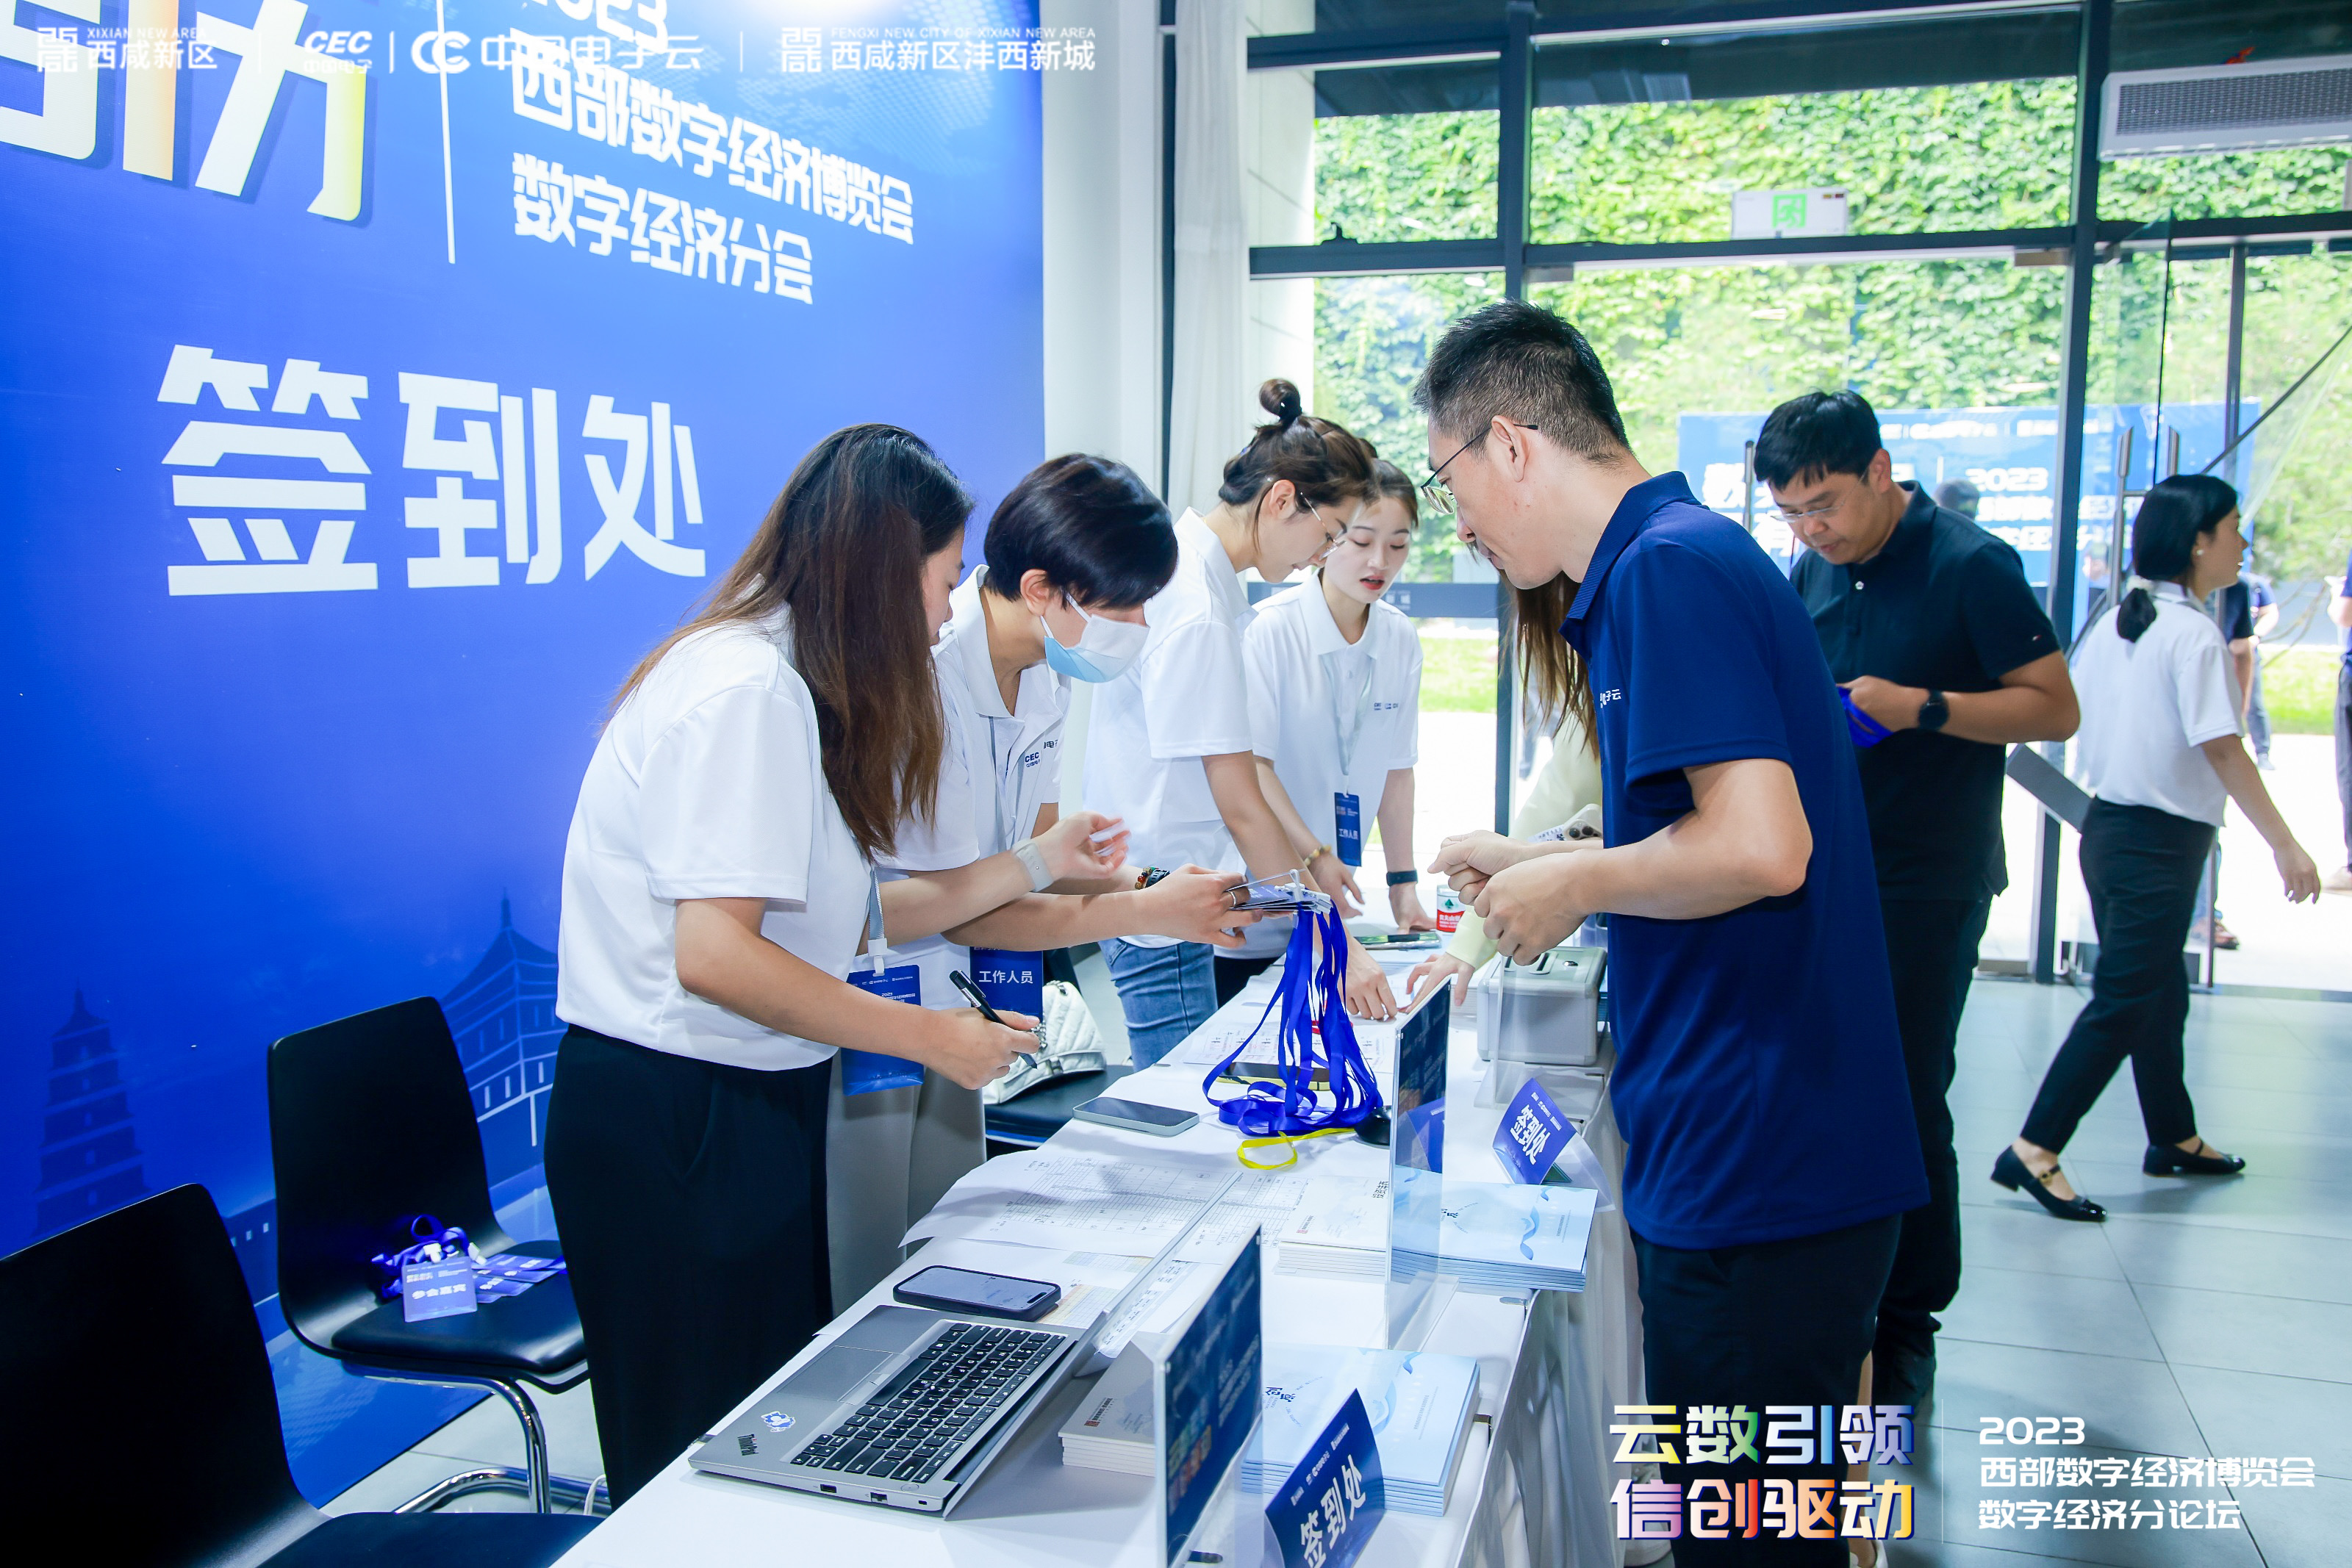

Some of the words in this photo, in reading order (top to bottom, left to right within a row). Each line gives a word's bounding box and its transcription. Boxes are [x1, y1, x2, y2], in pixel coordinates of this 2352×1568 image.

[510, 28, 914, 245] 西部数字经济博览会
[512, 152, 814, 304] 数字经济分会
[157, 345, 706, 597] 签到处
[1025, 752, 1039, 763] CEC
[978, 970, 1033, 984] 工作人员
[1510, 1104, 1551, 1165] 签到处
[737, 1434, 759, 1456] ThinkPad
[1300, 1454, 1366, 1568] 签到处
